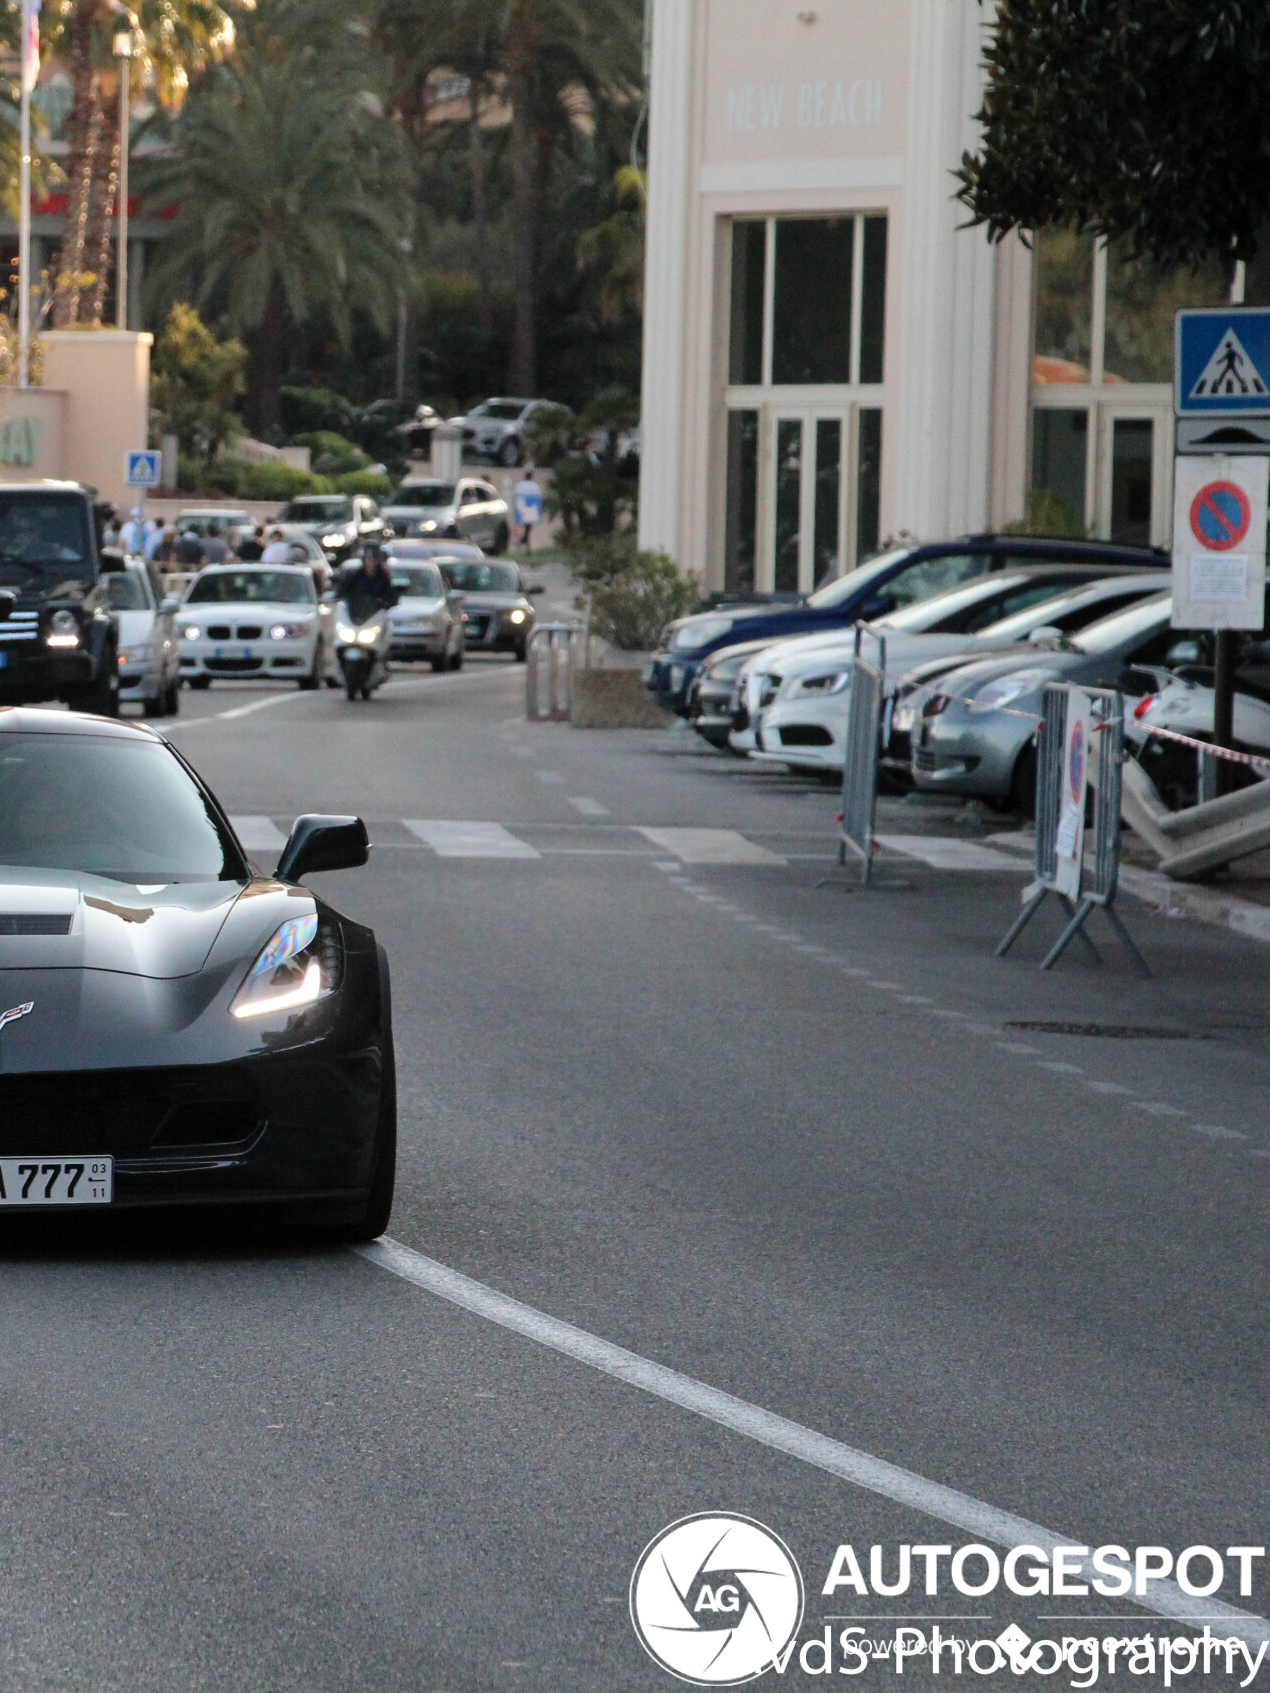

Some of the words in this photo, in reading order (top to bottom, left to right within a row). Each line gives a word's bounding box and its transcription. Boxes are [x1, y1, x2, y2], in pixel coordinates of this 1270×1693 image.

[727, 83, 785, 131] NEW
[798, 79, 883, 128] BEACH
[91, 1163, 106, 1174] 03
[18, 1163, 85, 1199] 777
[92, 1187, 105, 1198] 11
